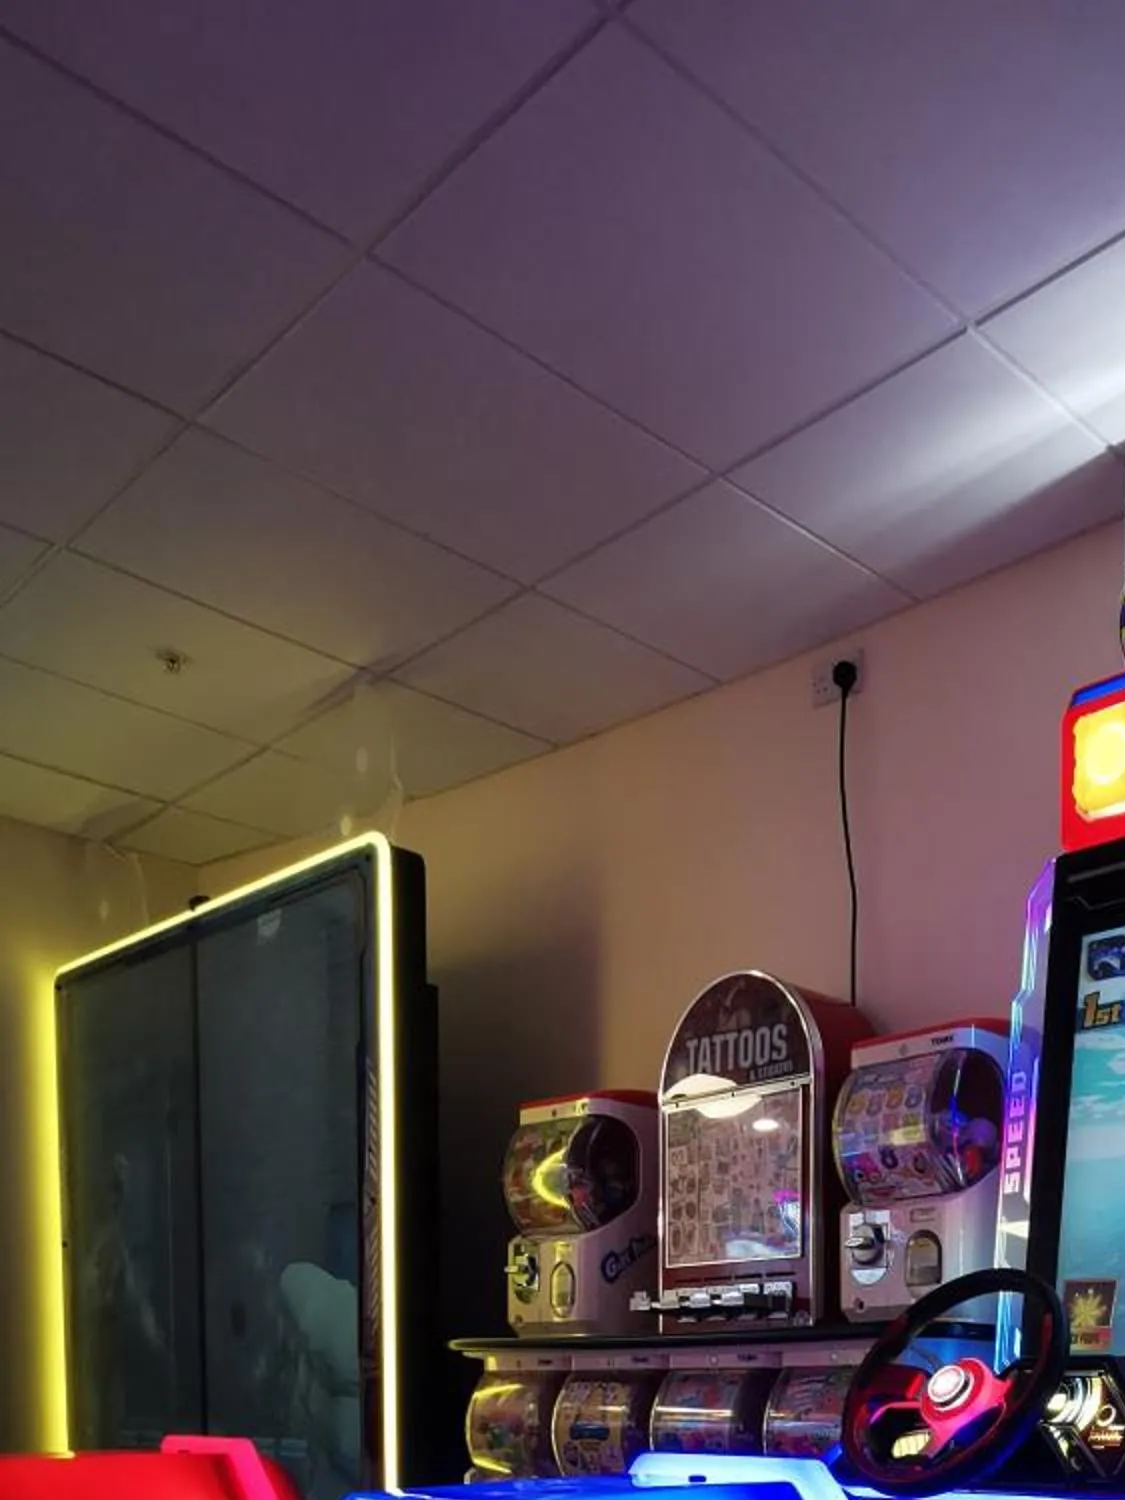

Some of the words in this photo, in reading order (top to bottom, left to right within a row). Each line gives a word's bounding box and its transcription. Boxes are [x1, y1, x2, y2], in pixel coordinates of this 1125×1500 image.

[1083, 991, 1122, 1029] 1st
[685, 1023, 788, 1076] TATTOOS
[1003, 1071, 1027, 1194] SPEED
